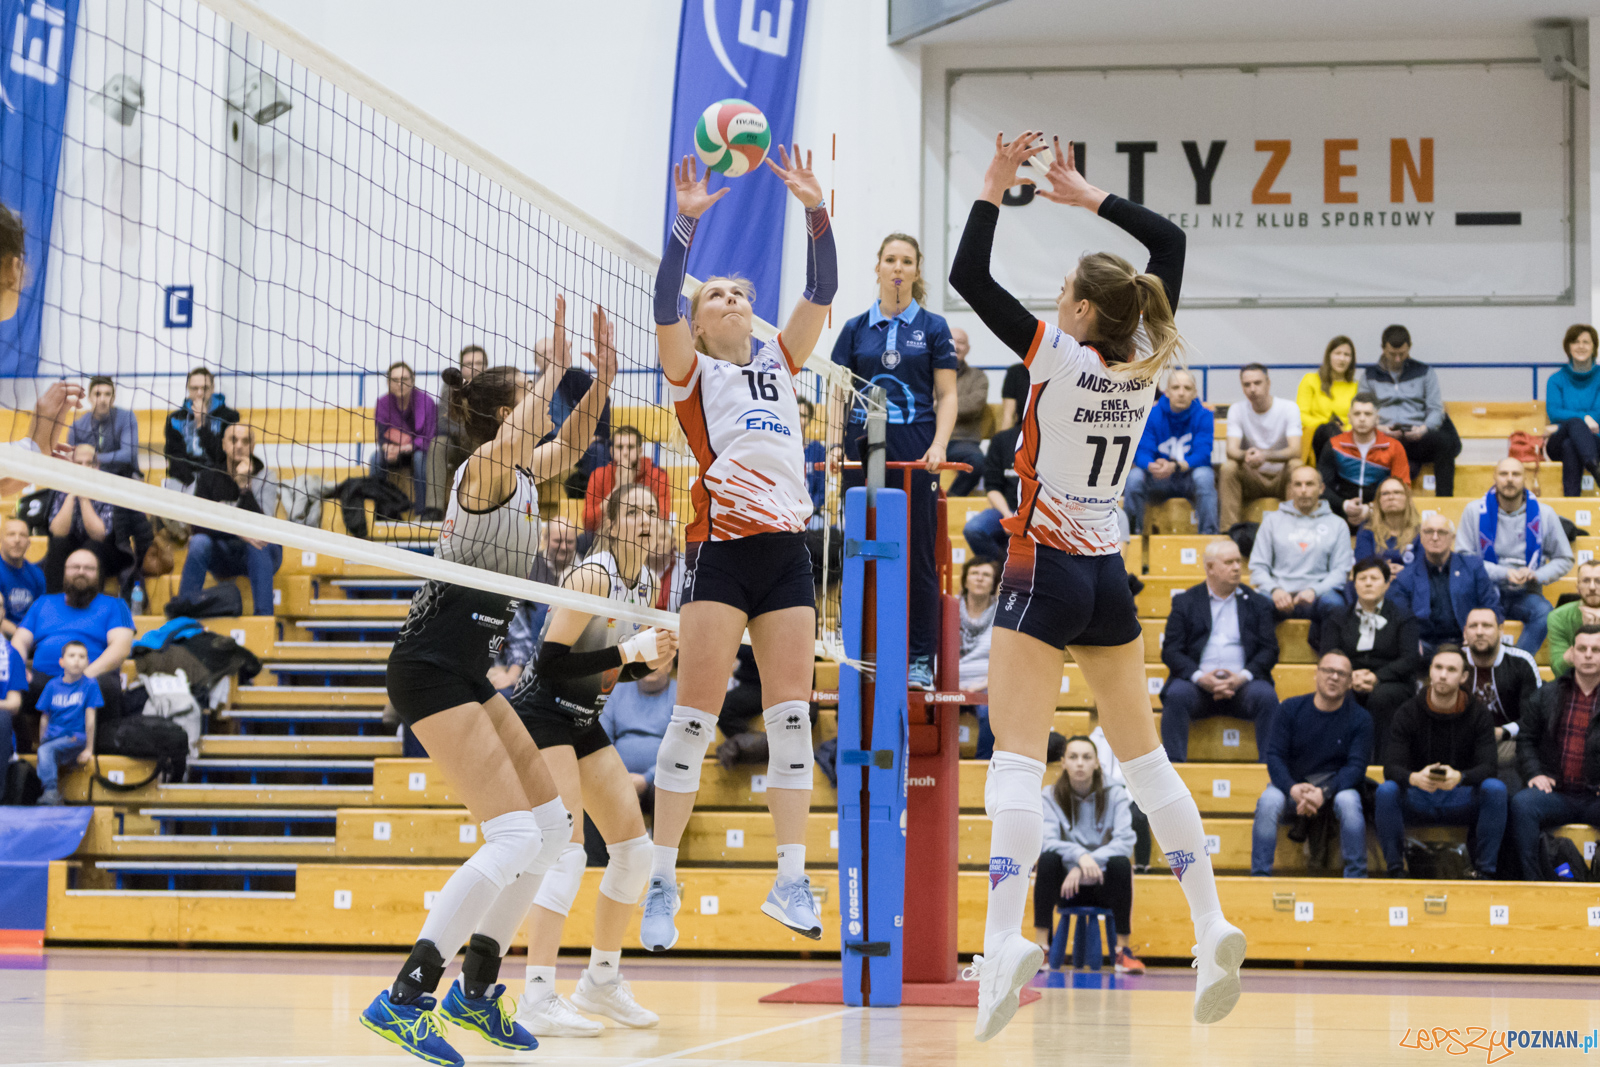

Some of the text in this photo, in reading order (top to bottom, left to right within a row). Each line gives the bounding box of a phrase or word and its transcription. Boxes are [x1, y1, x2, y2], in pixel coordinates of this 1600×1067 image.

[1212, 211, 1244, 228] NIŻ
[1257, 213, 1309, 228] KLUB
[1321, 211, 1435, 227] SPORTOWY
[742, 370, 779, 401] 16
[1101, 399, 1129, 410] ENEA
[746, 418, 791, 436] Enea
[1086, 436, 1131, 487] 77
[935, 693, 966, 702] Senoh
[849, 867, 860, 919] Senoh
[1299, 906, 1309, 914] 14
[1393, 911, 1404, 919] 13
[1495, 909, 1504, 917] 12
